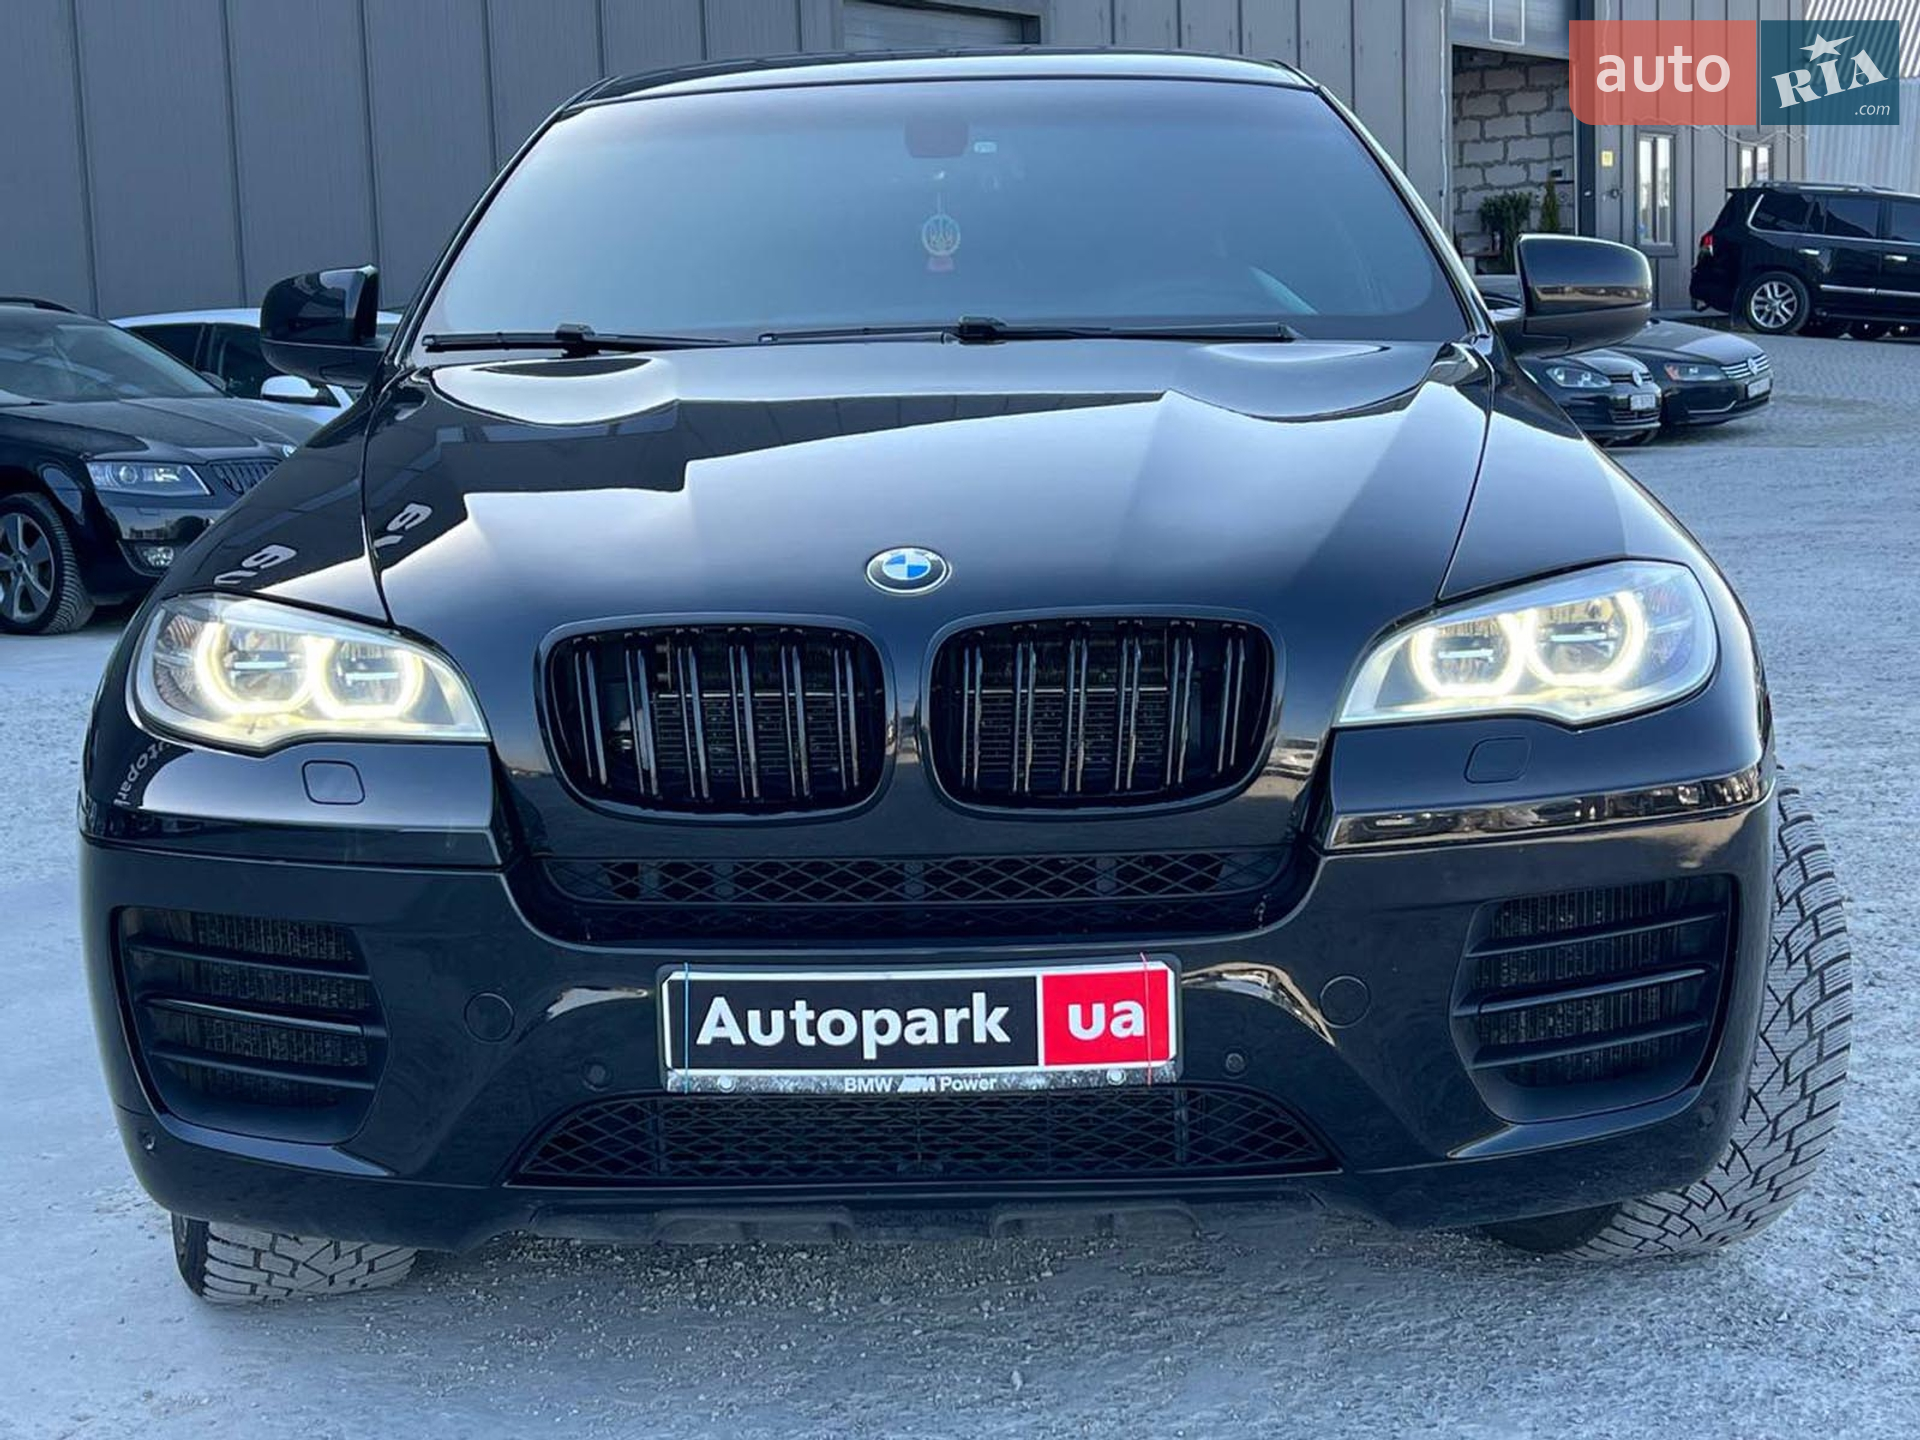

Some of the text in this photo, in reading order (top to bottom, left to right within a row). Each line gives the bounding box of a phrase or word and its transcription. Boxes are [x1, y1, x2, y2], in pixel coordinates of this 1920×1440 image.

[696, 992, 1146, 1060] Autopark ua
[844, 1076, 893, 1093] BMW
[939, 1075, 998, 1092] Power
